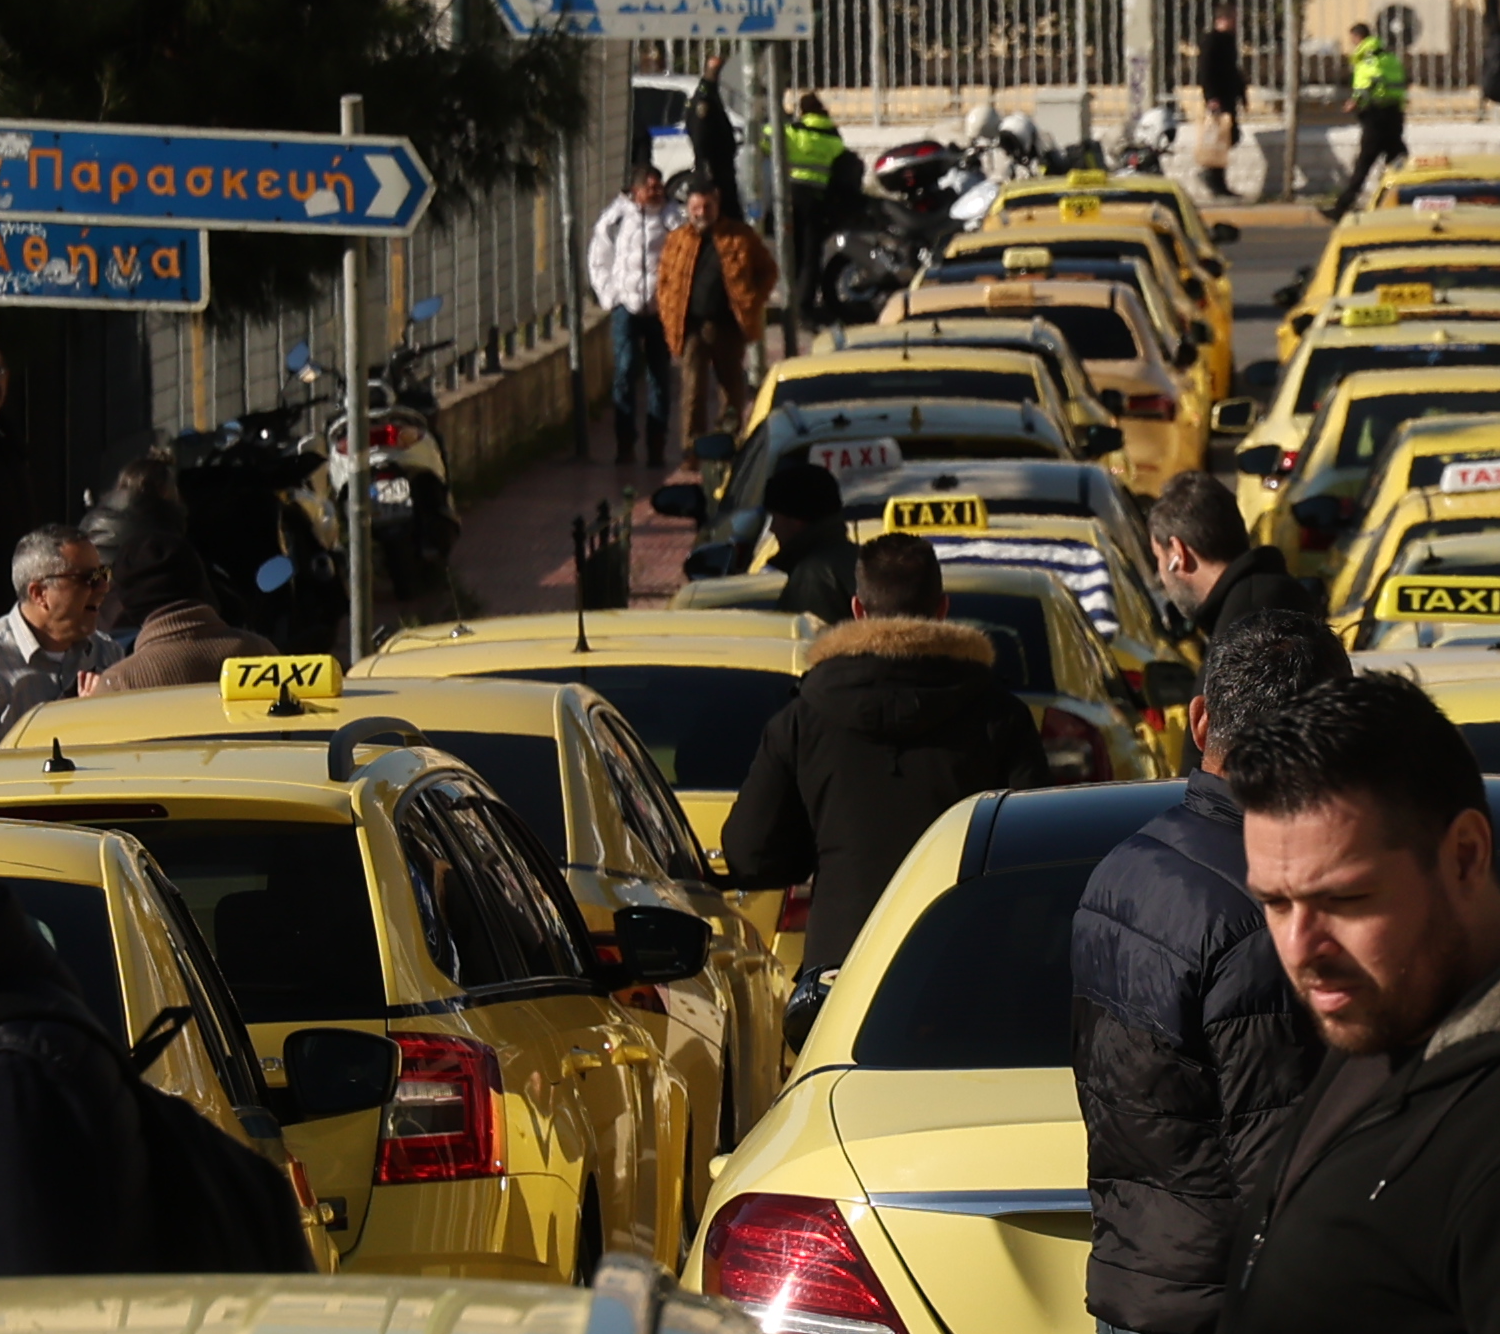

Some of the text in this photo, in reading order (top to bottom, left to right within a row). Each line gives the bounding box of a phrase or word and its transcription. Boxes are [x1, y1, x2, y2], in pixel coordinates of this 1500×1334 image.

[29, 147, 357, 214] Παρασκευή
[820, 447, 889, 468] TAXI
[899, 501, 972, 525] TAXI
[1403, 587, 1500, 613] TAXI
[237, 662, 324, 688] TAXI
